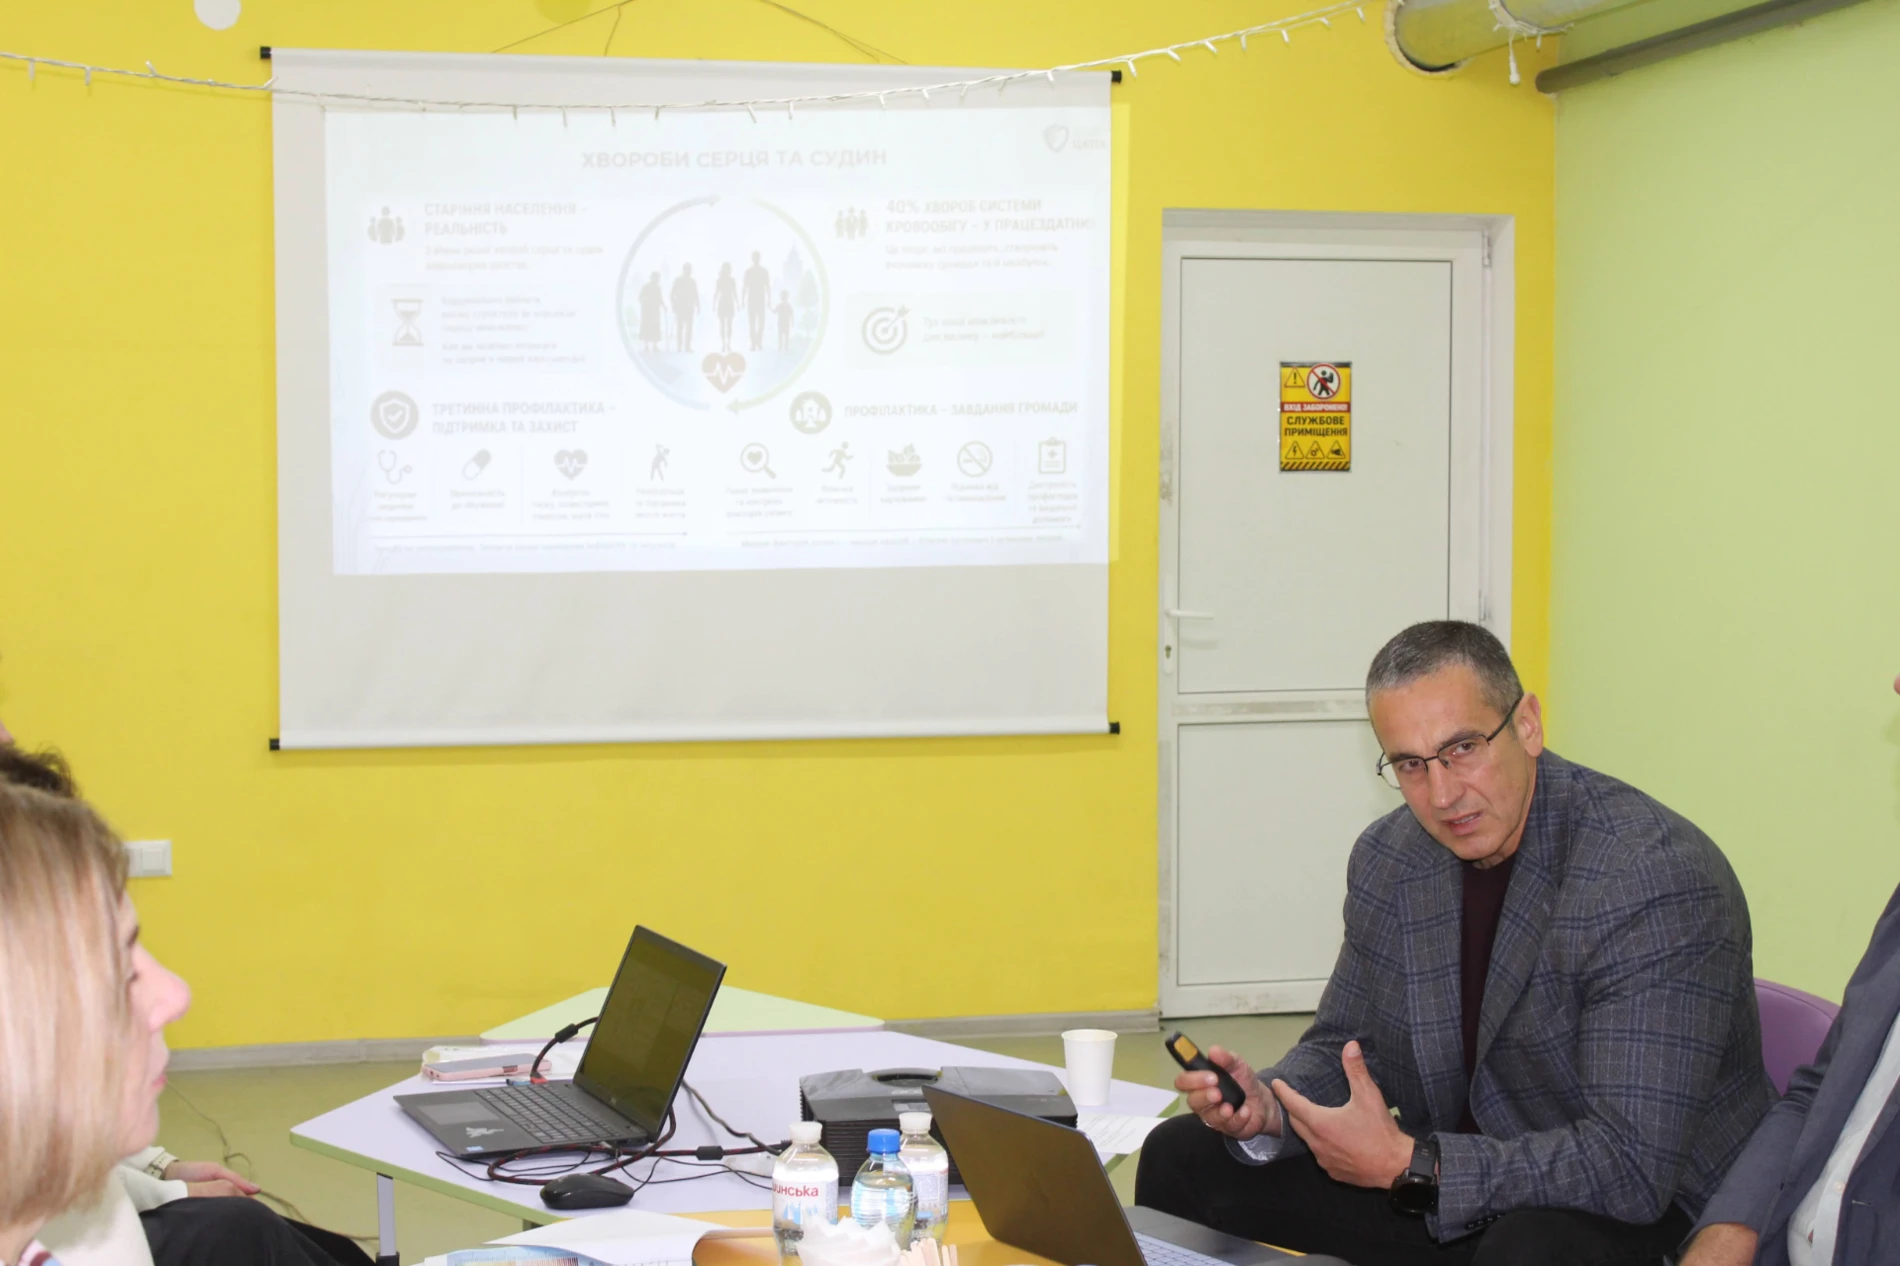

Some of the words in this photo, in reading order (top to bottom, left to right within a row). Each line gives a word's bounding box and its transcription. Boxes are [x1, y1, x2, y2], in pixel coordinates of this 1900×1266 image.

[582, 151, 690, 169] ХВОРОБИ
[696, 150, 769, 169] СЕРЦЯ
[775, 149, 804, 166] ТА
[810, 148, 887, 169] СУДИН
[424, 202, 491, 217] СТАРІННЯ
[495, 201, 577, 216] НАСЕЛЕННЯ
[886, 199, 919, 214] 40%
[924, 199, 976, 213] ХВОРОБ
[980, 198, 1042, 212] СИСТЕМИ
[424, 221, 508, 236] РЕАЛЬНІСТЬ
[885, 219, 968, 233] КРОВООБІГУ
[983, 219, 991, 232] У
[431, 403, 498, 416] ТРЕТИННА
[502, 401, 604, 416] ПРОФІЛАКТИКА
[844, 404, 938, 418] ПРОФІЛАКТИКА
[951, 402, 1015, 416] ЗАВДАННЯ
[1018, 401, 1078, 415] ГРОМАДИ
[431, 420, 508, 436] ПІДТРИМКА
[511, 420, 525, 434] ТА
[528, 419, 579, 434] ЗАХИСТ
[1286, 415, 1345, 425] СЛУЖБОВЕ
[1284, 427, 1348, 437] ПРИМІЩЕННЯ
